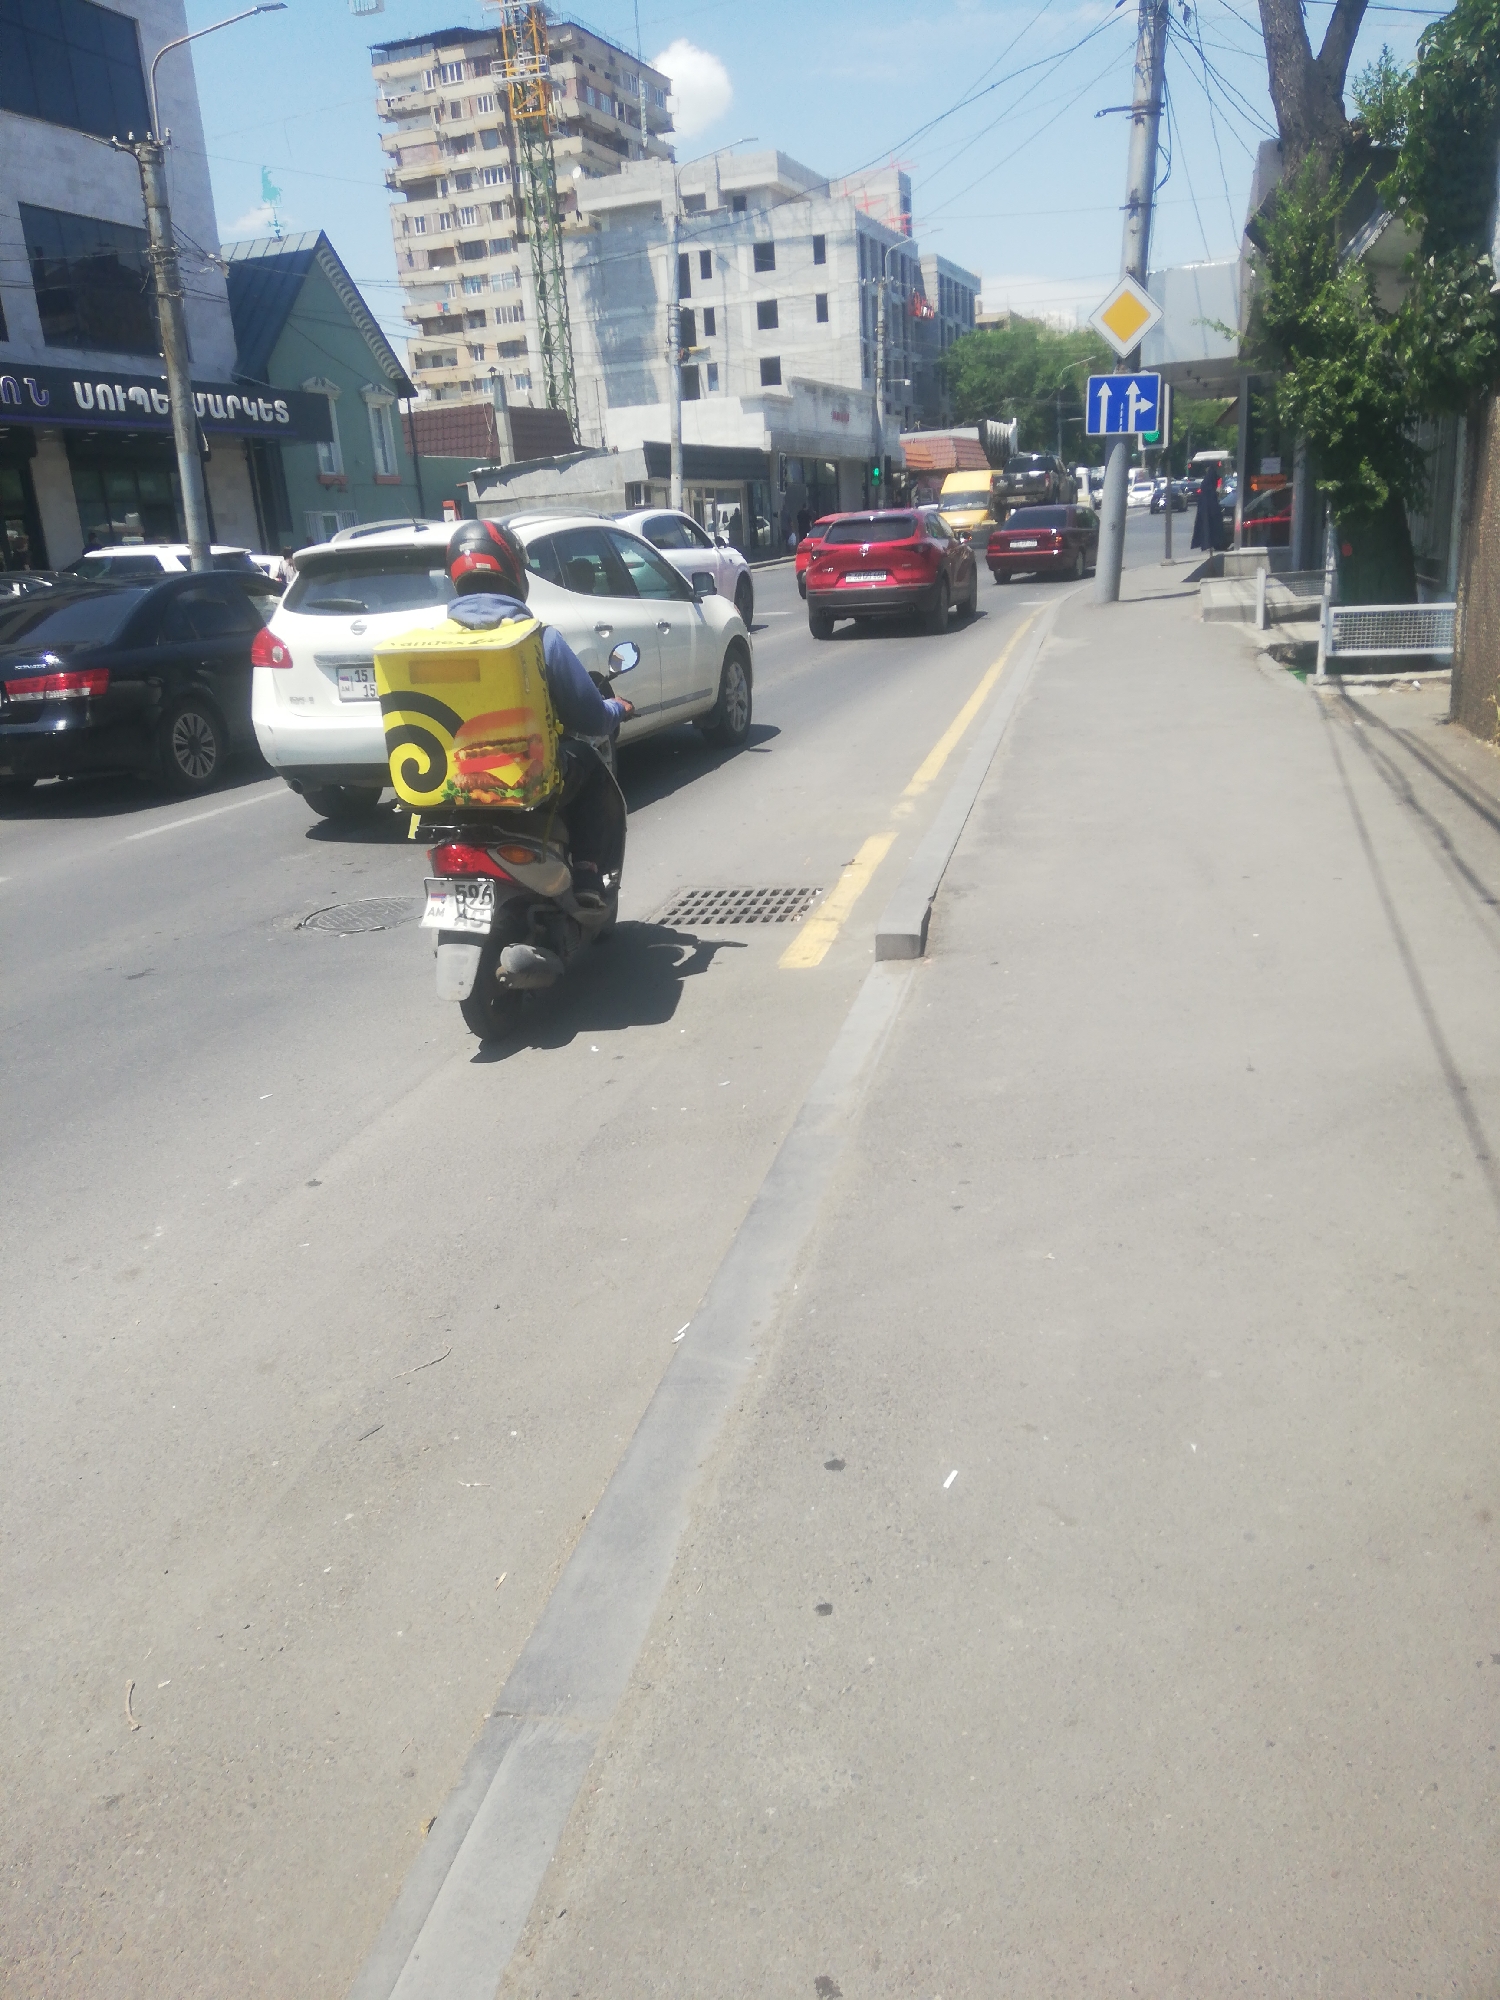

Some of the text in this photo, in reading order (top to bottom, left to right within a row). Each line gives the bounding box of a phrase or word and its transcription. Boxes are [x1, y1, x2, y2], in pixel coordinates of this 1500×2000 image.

[73, 381, 290, 424] ՍՈՒՊԵՄԱՐԿԵՏ
[362, 683, 377, 698] 15
[454, 884, 493, 906] 596
[426, 906, 446, 918] AM
